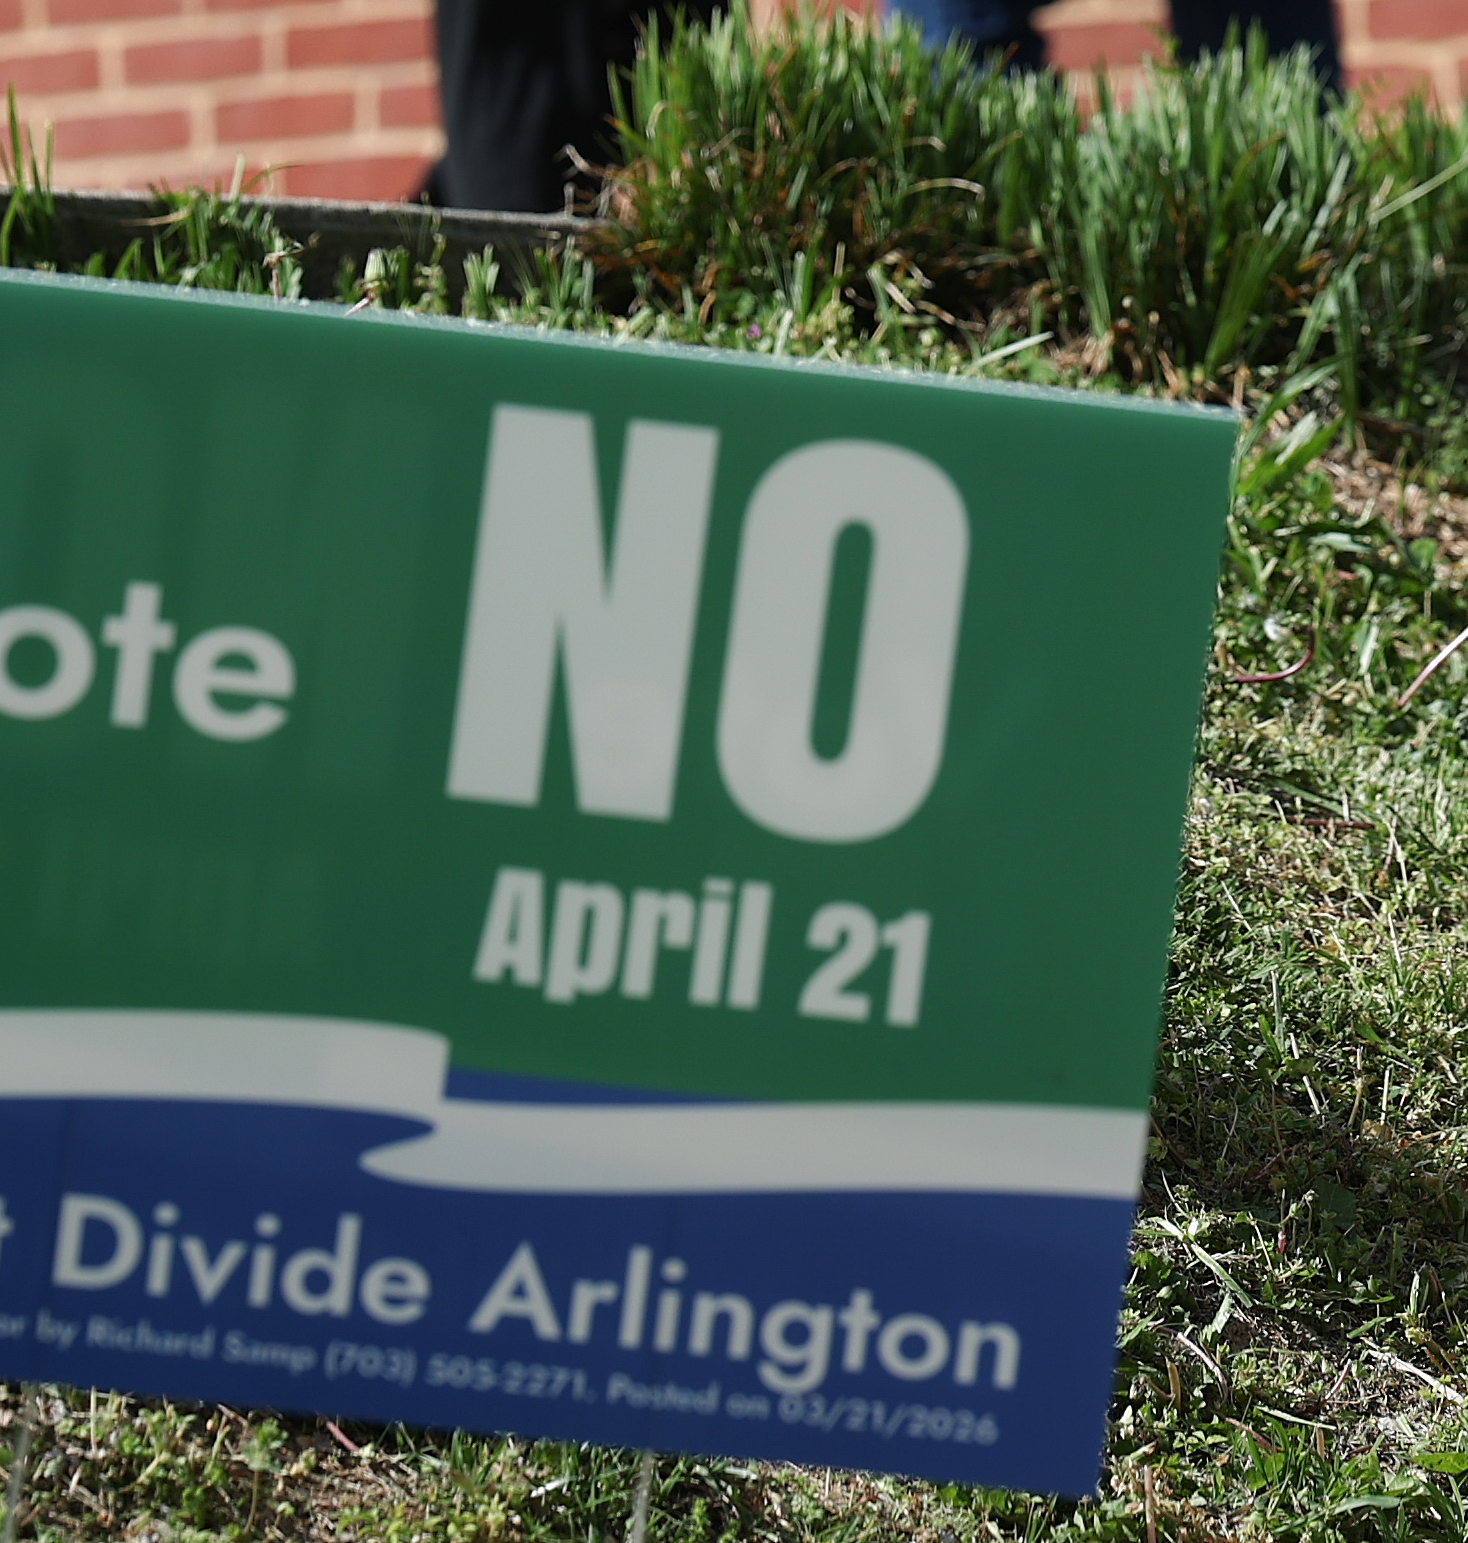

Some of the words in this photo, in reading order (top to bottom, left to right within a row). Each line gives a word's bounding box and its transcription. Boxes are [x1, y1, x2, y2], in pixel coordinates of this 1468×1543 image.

[445, 401, 970, 846] NO
[472, 866, 774, 1011] April
[797, 900, 933, 1028] 21
[36, 1307, 79, 1350] by
[86, 1314, 217, 1359] Richard
[324, 1340, 419, 1388] (703)
[606, 1371, 722, 1416] Posted
[726, 1392, 772, 1421] on
[777, 1391, 1000, 1447] 03/21/2026
[51, 1192, 431, 1326] Divide
[469, 1242, 1022, 1397] Arlington
